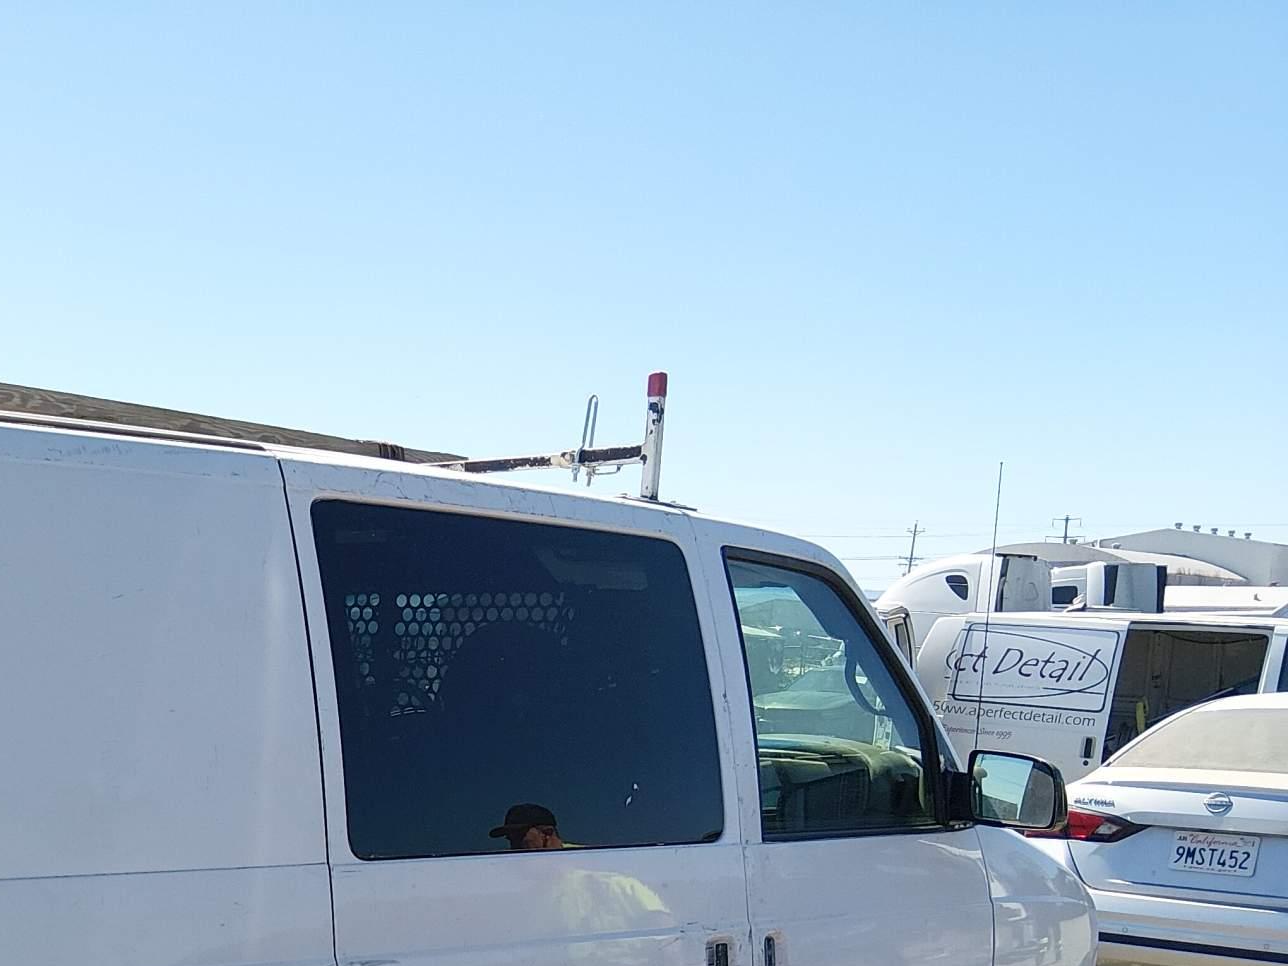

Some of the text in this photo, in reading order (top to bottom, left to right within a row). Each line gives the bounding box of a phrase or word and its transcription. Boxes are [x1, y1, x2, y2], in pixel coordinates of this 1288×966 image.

[992, 648, 1102, 683] Detail
[1189, 834, 1241, 848] California
[1174, 845, 1251, 871] 9MST452
